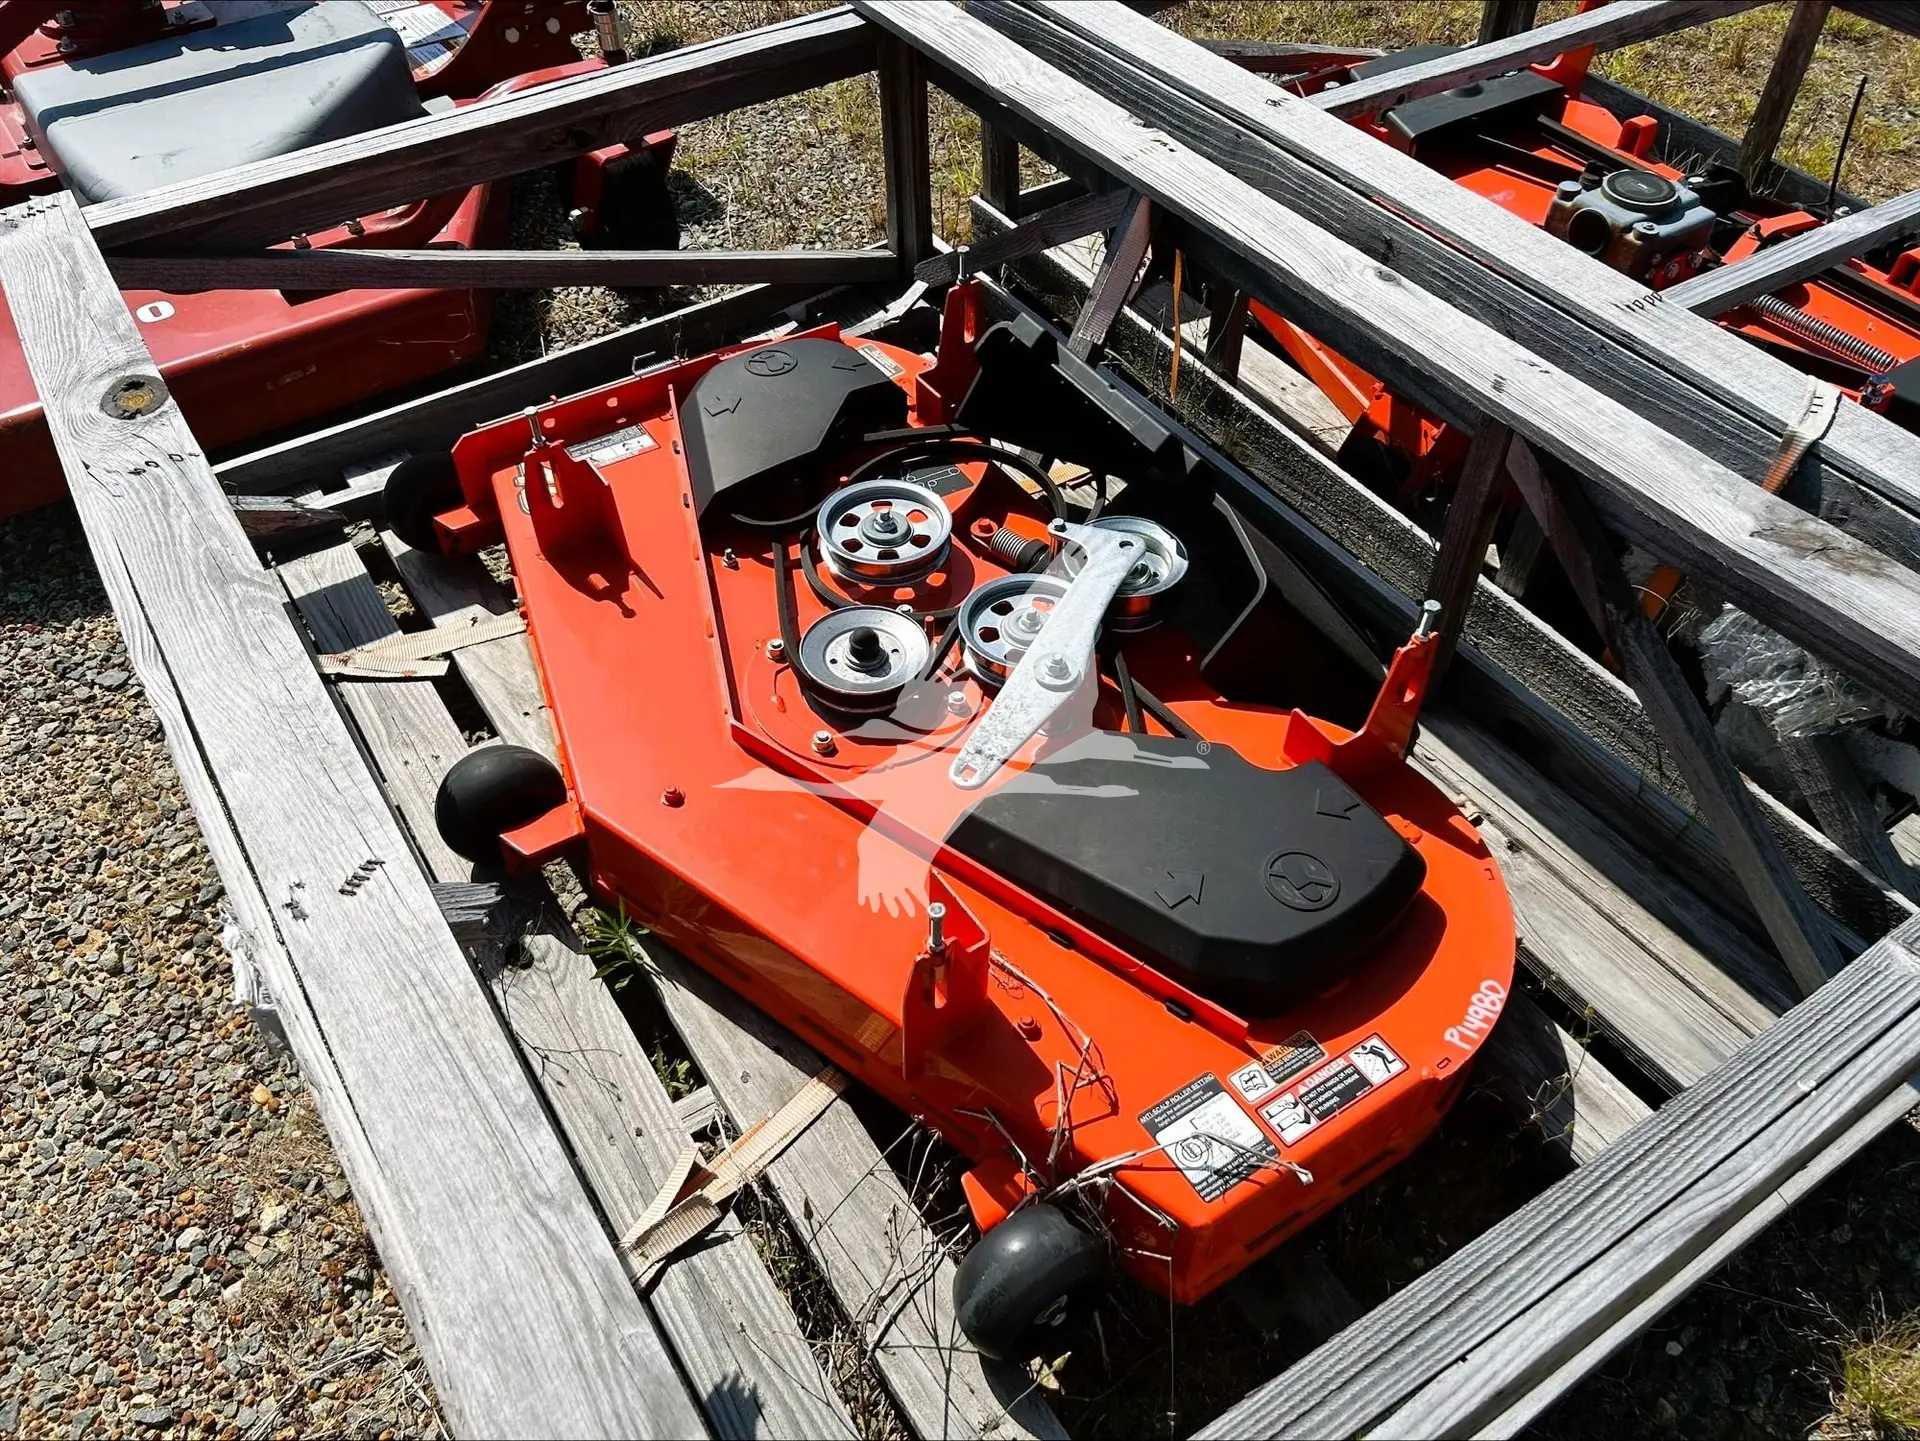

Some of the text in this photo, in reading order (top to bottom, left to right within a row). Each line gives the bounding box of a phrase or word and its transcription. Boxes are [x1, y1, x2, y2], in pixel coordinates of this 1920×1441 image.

[1265, 1033, 1307, 1061] WARNING
[1168, 1086, 1192, 1104] ROLLER
[1189, 1072, 1215, 1091] SETTING
[1300, 1065, 1355, 1103] DO NOT PUT HANDS OR FEET
[1303, 1056, 1348, 1088] DANGER
[1306, 1098, 1319, 1109] INTO
[1315, 1088, 1334, 1103] MOWER
[1342, 1072, 1360, 1085] ENGINE
